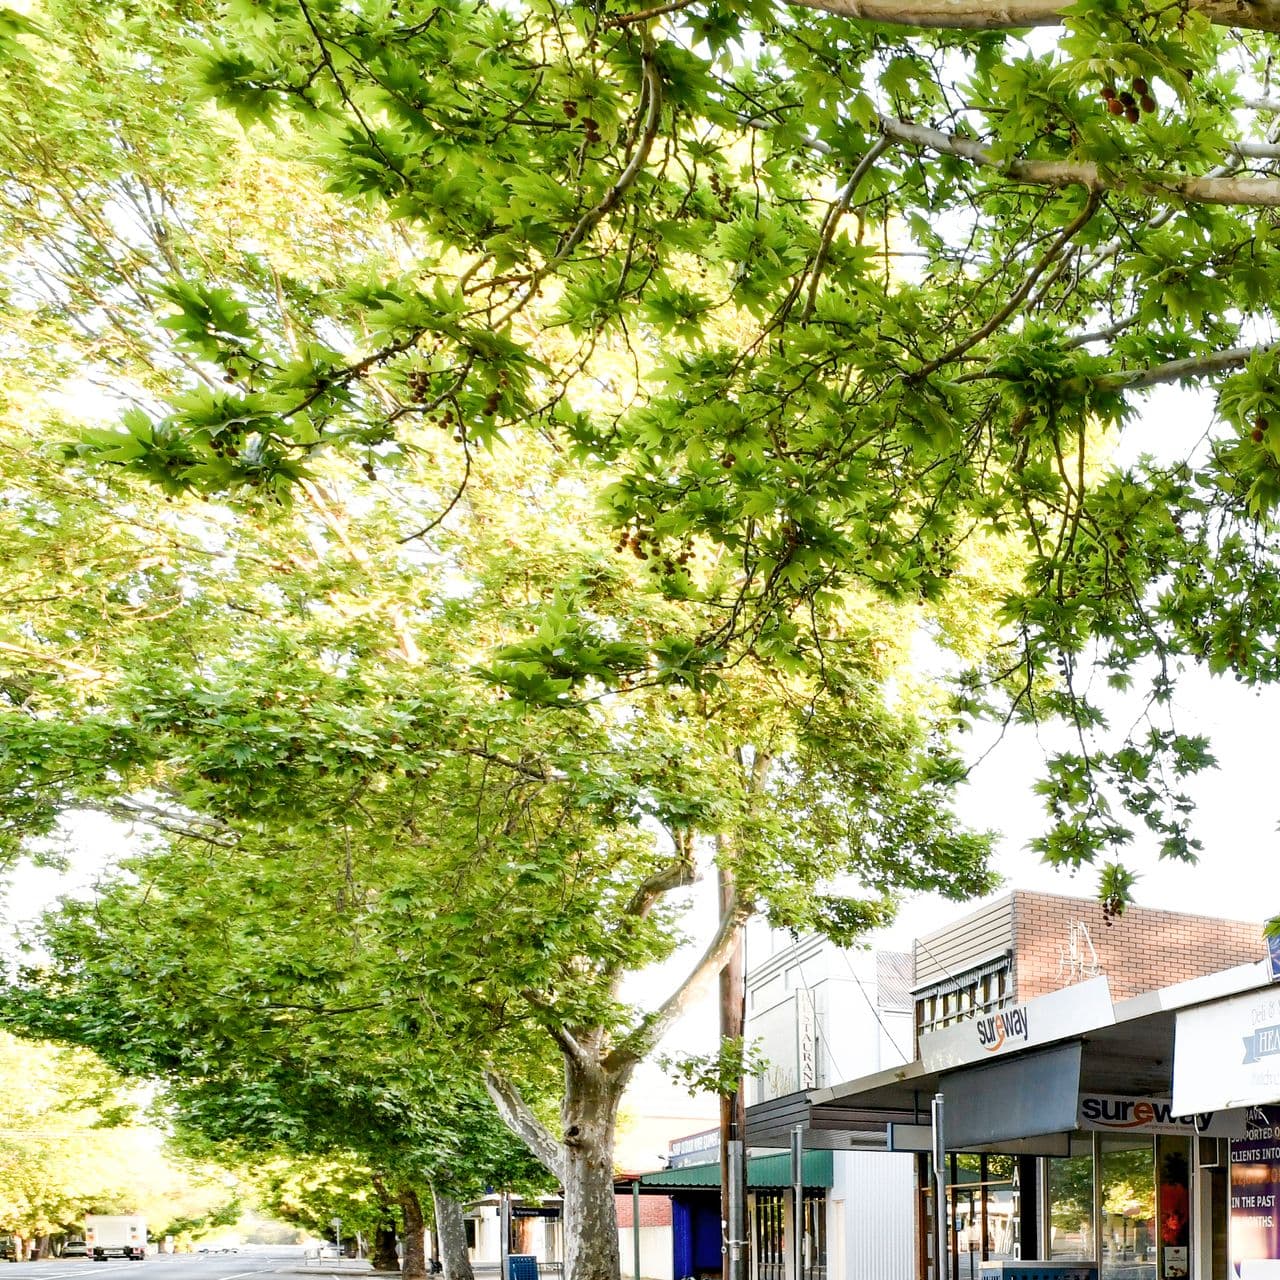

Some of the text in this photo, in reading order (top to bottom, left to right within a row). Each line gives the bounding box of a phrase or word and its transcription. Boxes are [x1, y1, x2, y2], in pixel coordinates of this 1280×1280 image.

[977, 1007, 1029, 1052] sureway
[802, 993, 815, 1091] STAURANT
[1231, 1127, 1272, 1144] PORTED
[1231, 1149, 1261, 1163] CLIENTS
[1263, 1147, 1280, 1160] INTO
[1232, 1195, 1276, 1208] IN THE PAST
